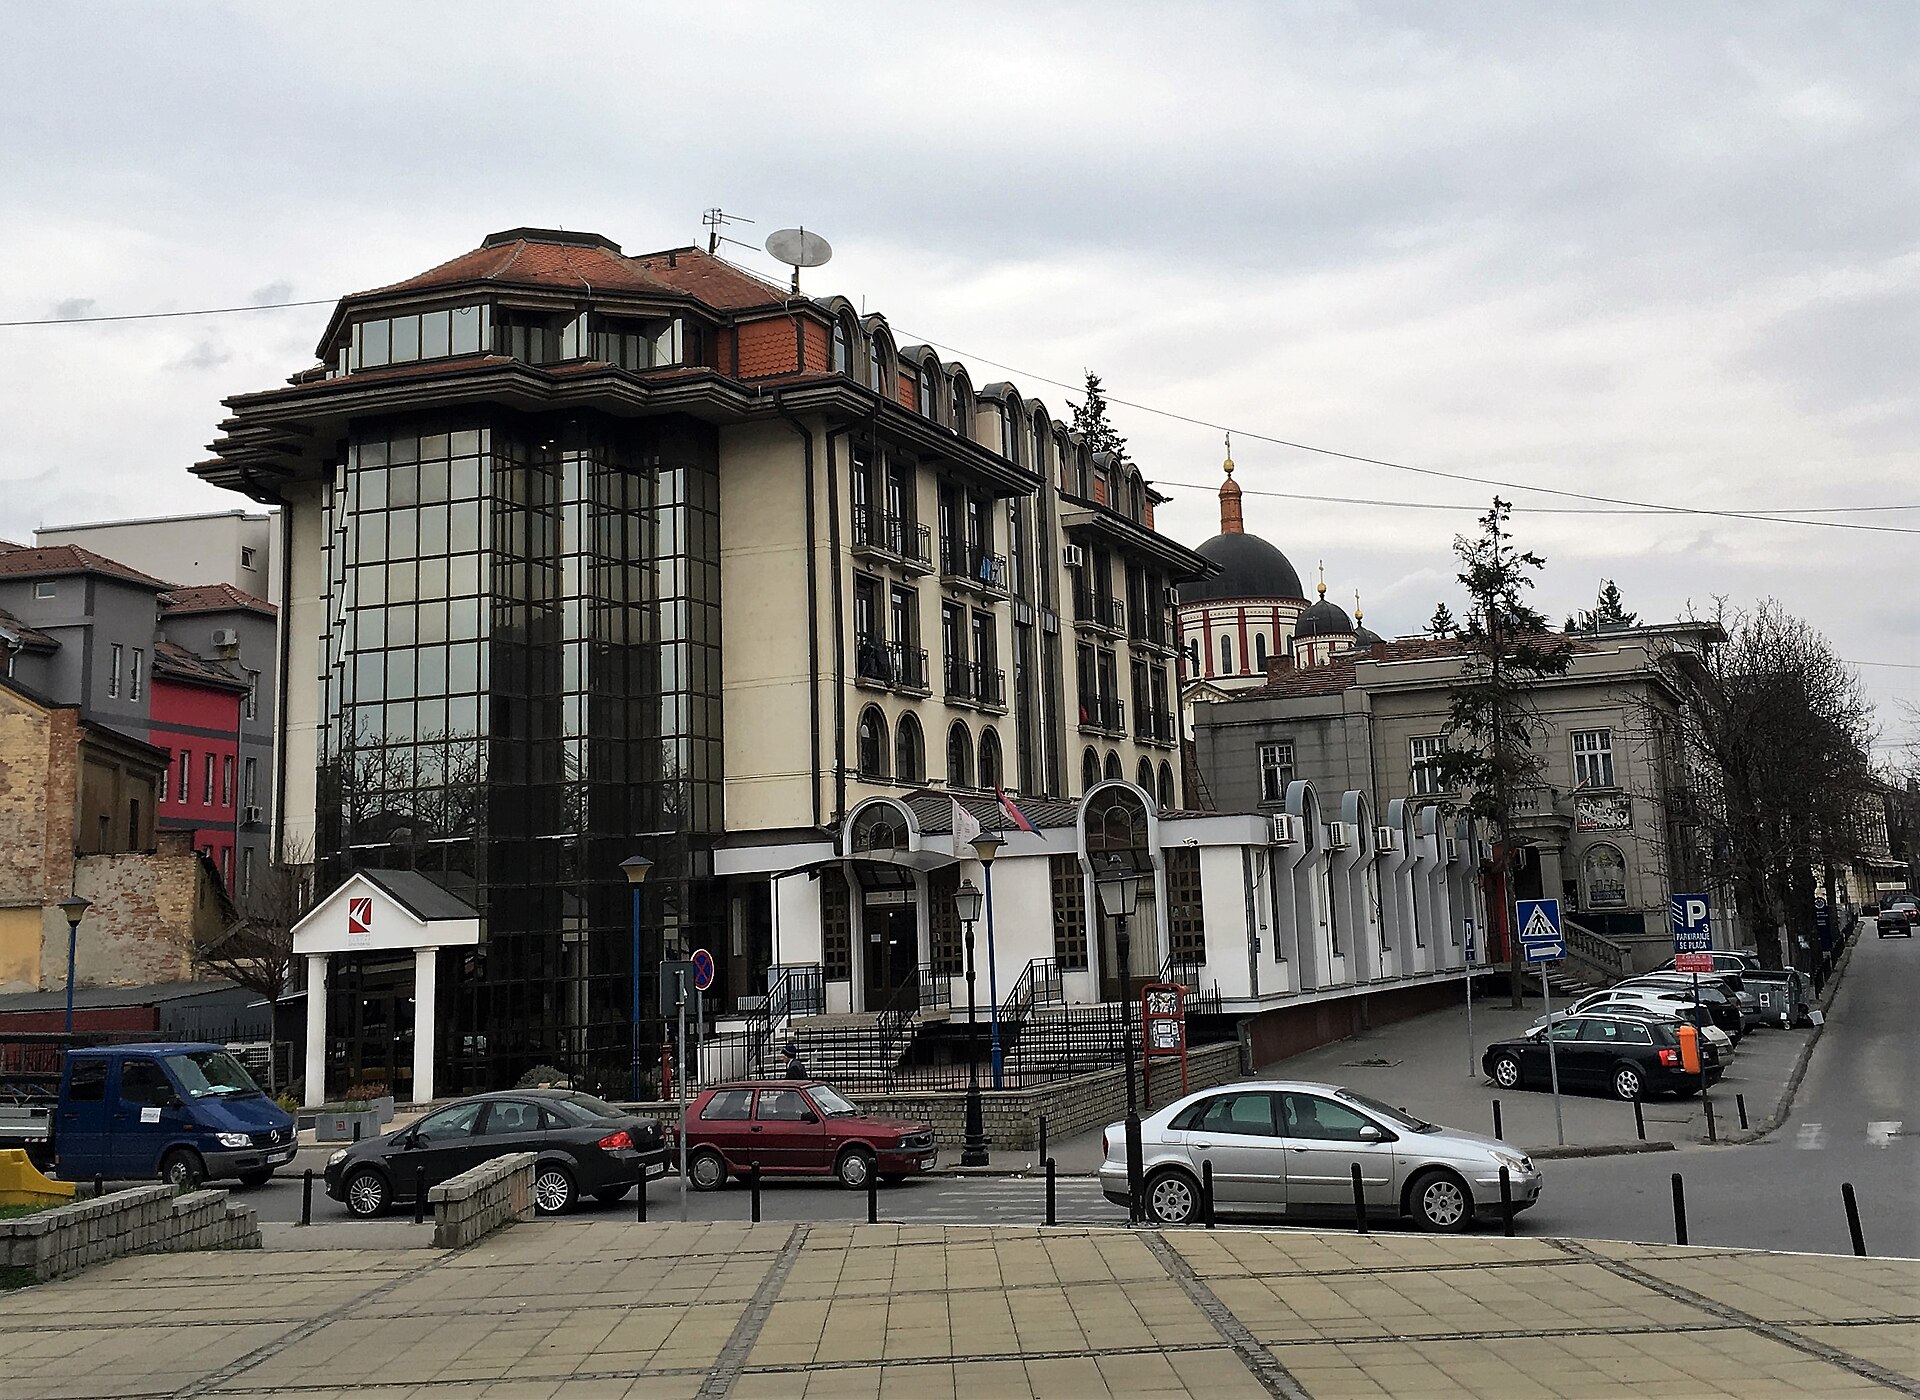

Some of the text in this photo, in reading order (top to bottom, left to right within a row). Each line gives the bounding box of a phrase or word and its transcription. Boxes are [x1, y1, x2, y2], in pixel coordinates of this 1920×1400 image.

[1686, 900, 1706, 928] P
[1466, 922, 1472, 946] P
[1702, 923, 1709, 932] 3
[1676, 933, 1710, 941] PARKIRANJE
